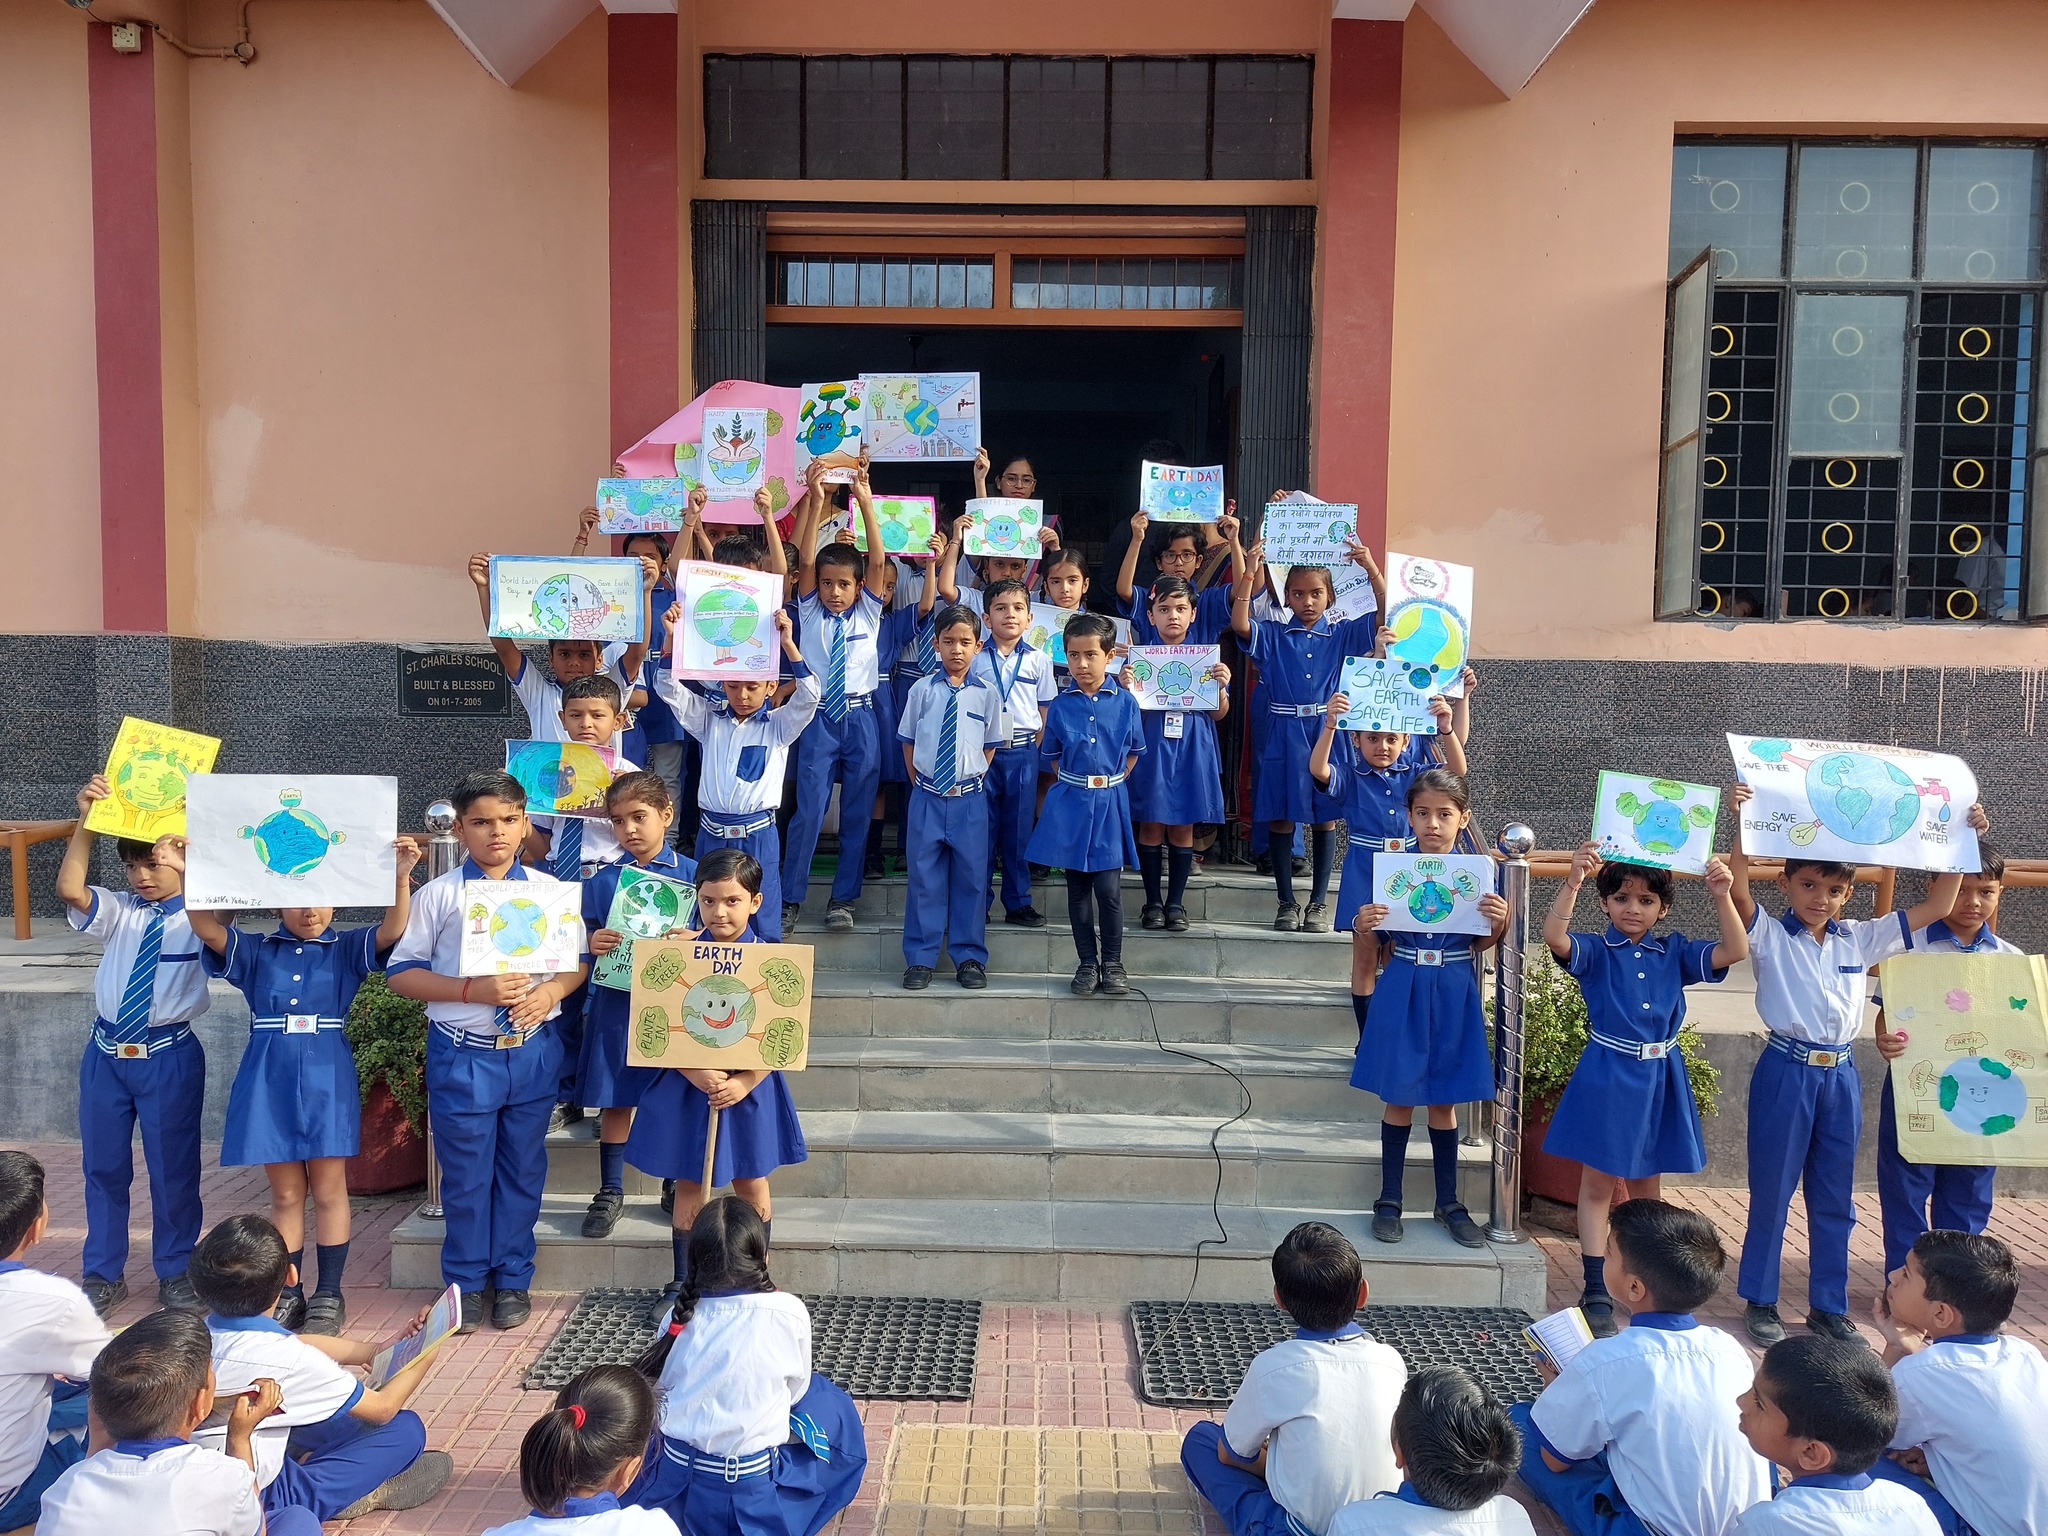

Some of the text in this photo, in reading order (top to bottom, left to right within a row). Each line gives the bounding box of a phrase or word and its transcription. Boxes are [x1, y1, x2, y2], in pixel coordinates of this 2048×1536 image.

[1150, 466, 1220, 482] EARTH DAY
[1278, 521, 1293, 530] का
[500, 574, 539, 585] World Earth
[598, 579, 613, 587] Save
[506, 586, 521, 598] Day
[1334, 582, 1355, 596] Earth
[1144, 646, 1210, 655] WORLD EARTH DAY
[406, 654, 503, 677] ST. CHARLES SCHOOL
[1352, 665, 1406, 690] SAVE
[413, 680, 496, 691] BUILT & BLESSED
[427, 697, 440, 706] ON
[1374, 689, 1420, 711] EARTH
[1346, 701, 1391, 721] SAVE
[1389, 715, 1424, 732] LIFE
[132, 723, 210, 752] Happy Earth Day
[1805, 741, 1853, 751] WORLD
[1857, 744, 1901, 755] EARTH
[1738, 760, 1790, 772] SAVE TREE
[99, 808, 117, 818] April
[1771, 811, 1797, 823] SAVE
[1744, 819, 1782, 832] ENERGY
[1926, 820, 1948, 834] SAVE
[1919, 830, 1948, 845] WATER
[1417, 860, 1443, 870] EARTH
[482, 884, 560, 894] WORLD EARTH DAY
[1388, 870, 1406, 897] HAPPY
[1458, 874, 1475, 893] DAY
[467, 936, 485, 947] SAVE
[466, 947, 485, 956] TREE
[693, 945, 743, 961] EARTH
[645, 953, 669, 981] SAVE
[712, 961, 743, 975] DAY
[654, 962, 680, 987] TREES
[777, 964, 800, 988] SAVE
[765, 967, 791, 997] WATER
[640, 1011, 657, 1050] PLANTS
[655, 1025, 666, 1041] IN
[766, 1028, 779, 1051] OUT
[778, 1019, 796, 1067] POLLUTION
[1953, 1037, 1979, 1047] EARTH
[2012, 1051, 2027, 1063] DAY
[1909, 1121, 1927, 1129] TREE
